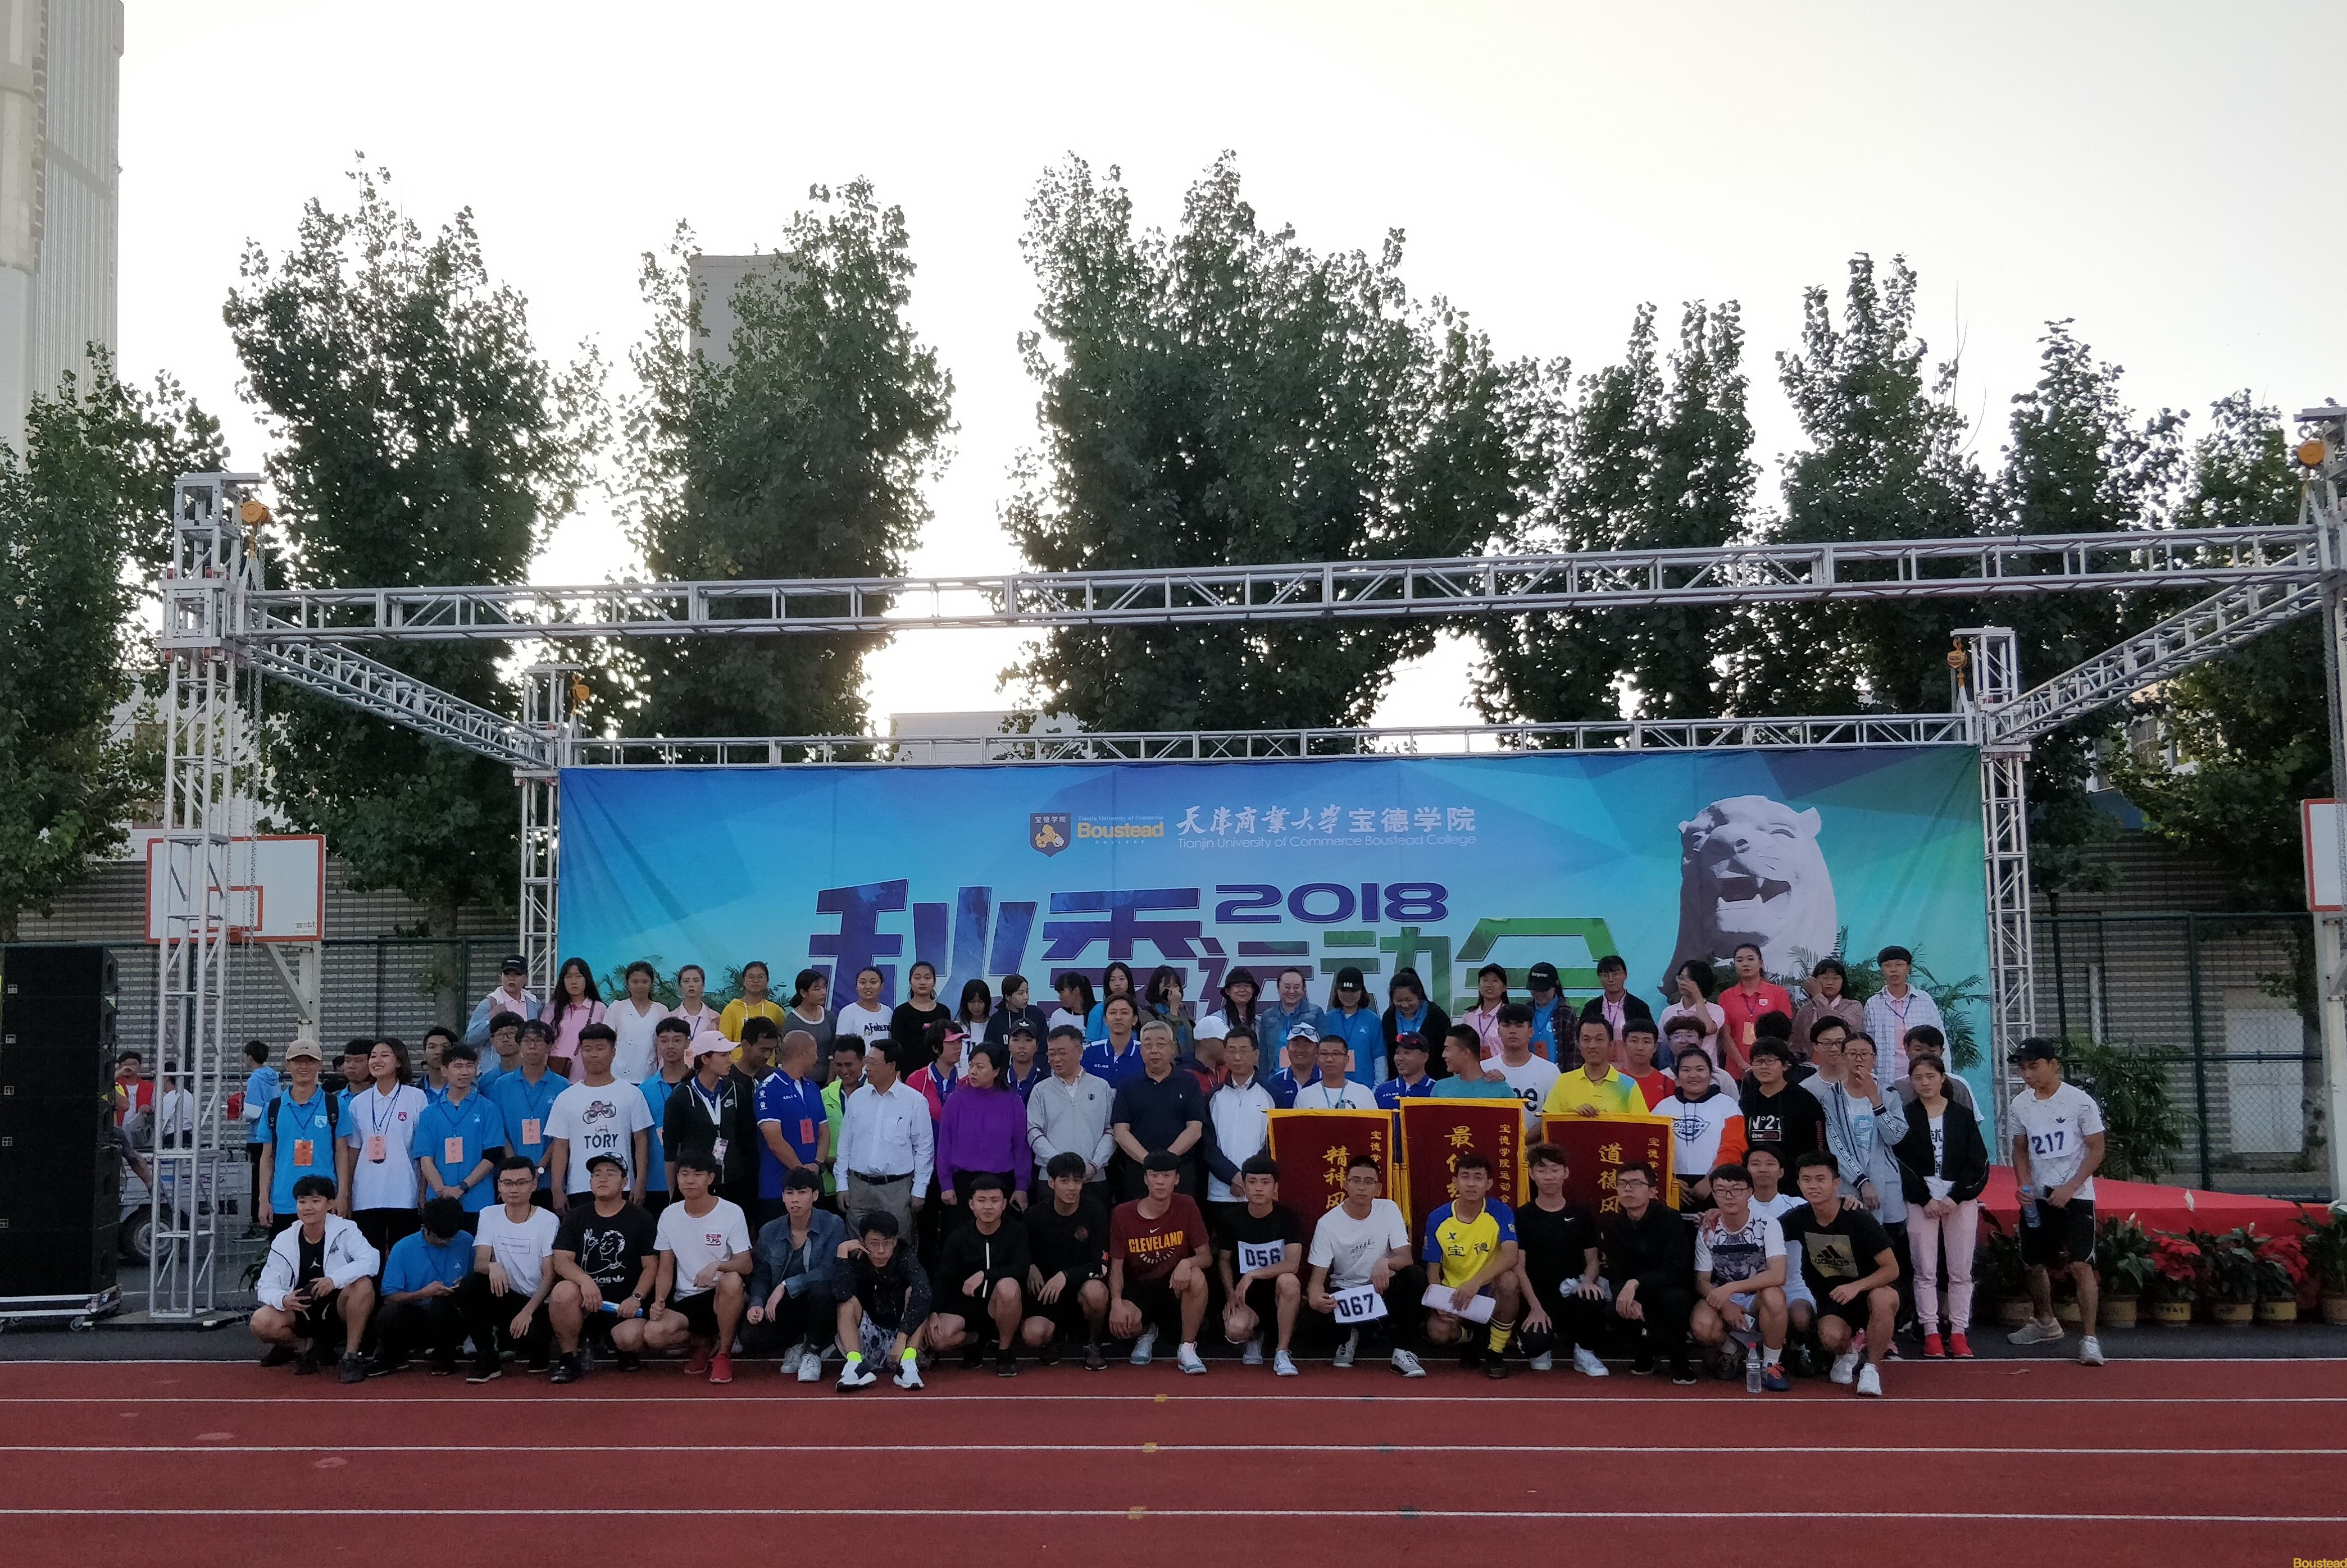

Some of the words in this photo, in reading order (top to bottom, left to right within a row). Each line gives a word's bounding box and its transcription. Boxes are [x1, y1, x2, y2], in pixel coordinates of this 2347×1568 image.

[1077, 821, 1165, 838] Boustead
[1178, 838, 1214, 850] Tianjin
[1217, 837, 1271, 849] University
[1274, 836, 1286, 847] of
[1289, 836, 1362, 846] Commerce
[1365, 835, 1423, 845] Boustead
[1426, 834, 1476, 846] College
[1215, 882, 1449, 923] 2018
[584, 1133, 619, 1148] TORY
[2031, 1131, 2064, 1155] 217
[1128, 1230, 1183, 1253] CLEVELAND
[1338, 1293, 1373, 1317] 067
